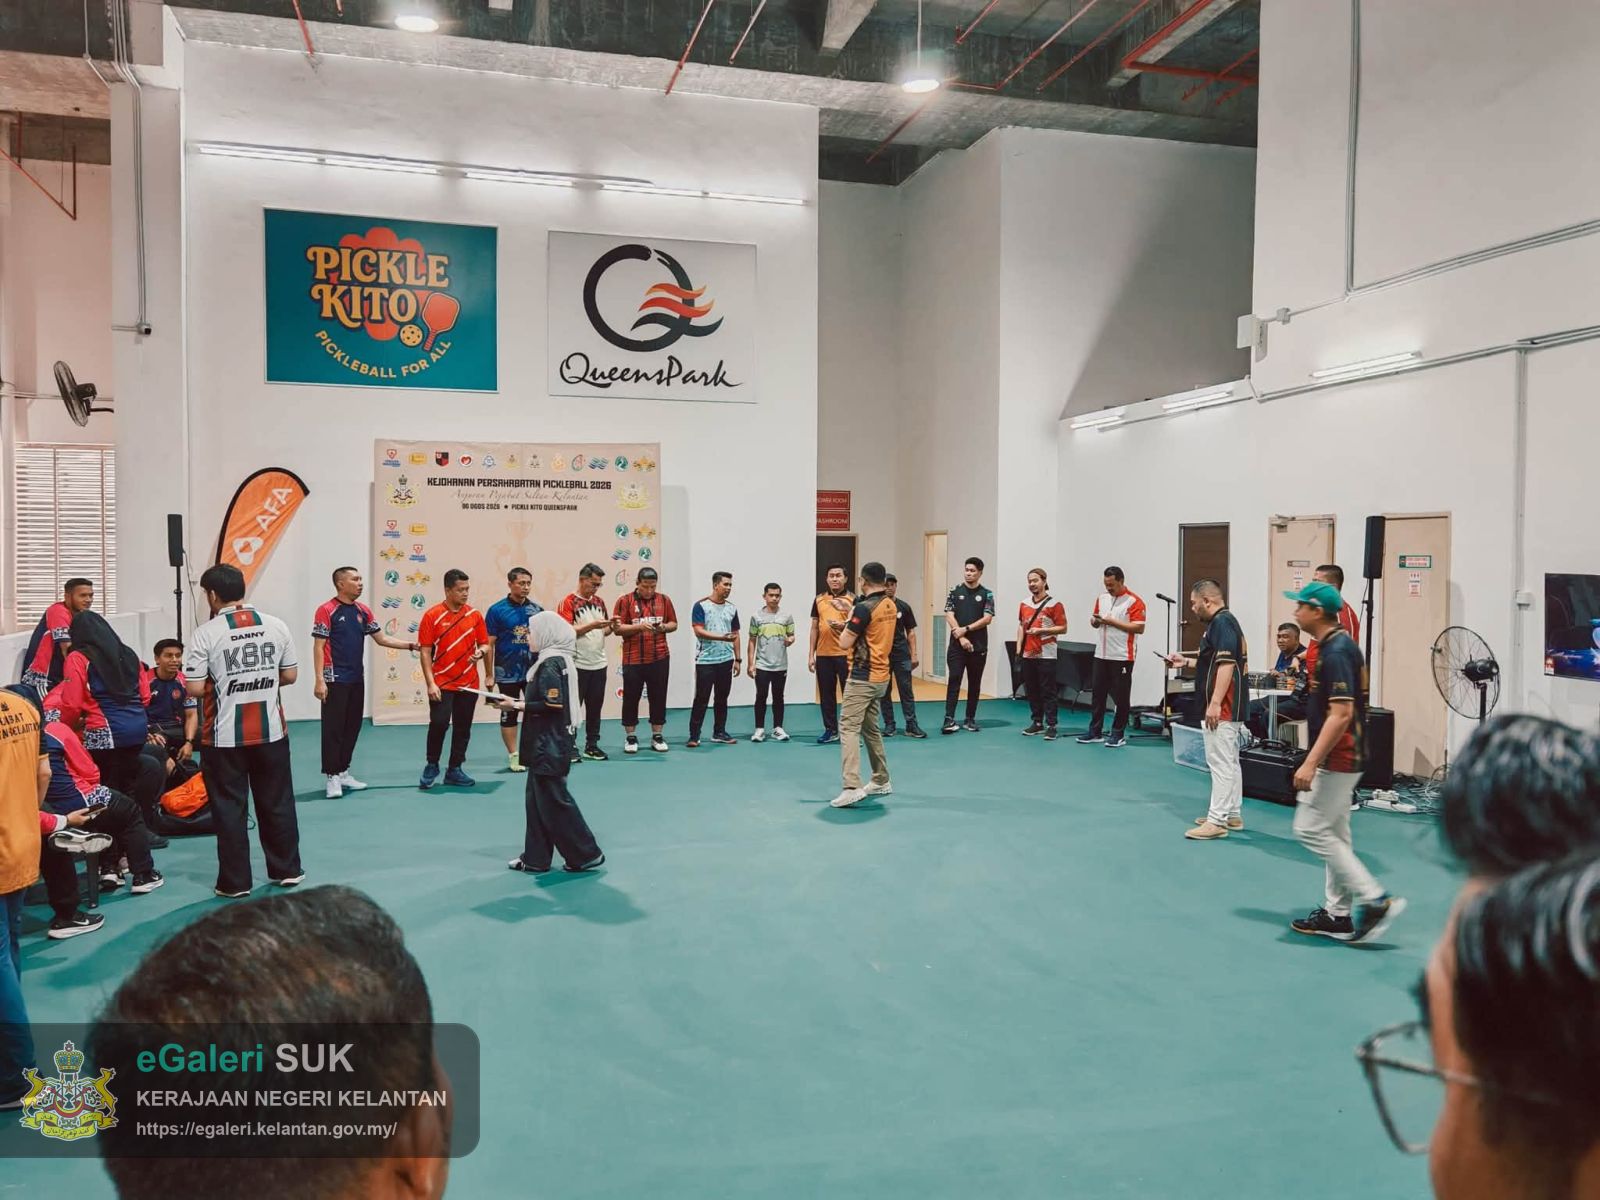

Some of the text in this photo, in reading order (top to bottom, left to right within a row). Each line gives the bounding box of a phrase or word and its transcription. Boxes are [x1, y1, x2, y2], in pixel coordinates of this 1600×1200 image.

[306, 246, 449, 287] PICKLE
[311, 284, 417, 328] KITO
[315, 330, 452, 378] PICKLEBALL FOR ALL
[559, 352, 744, 388] QueensPark
[427, 477, 612, 490] KEJOHANAN PERSAHABATAN PICKLEBALL 2026
[256, 488, 293, 532] AFA
[511, 503, 529, 511] PICKLE
[230, 631, 265, 641] DANNY
